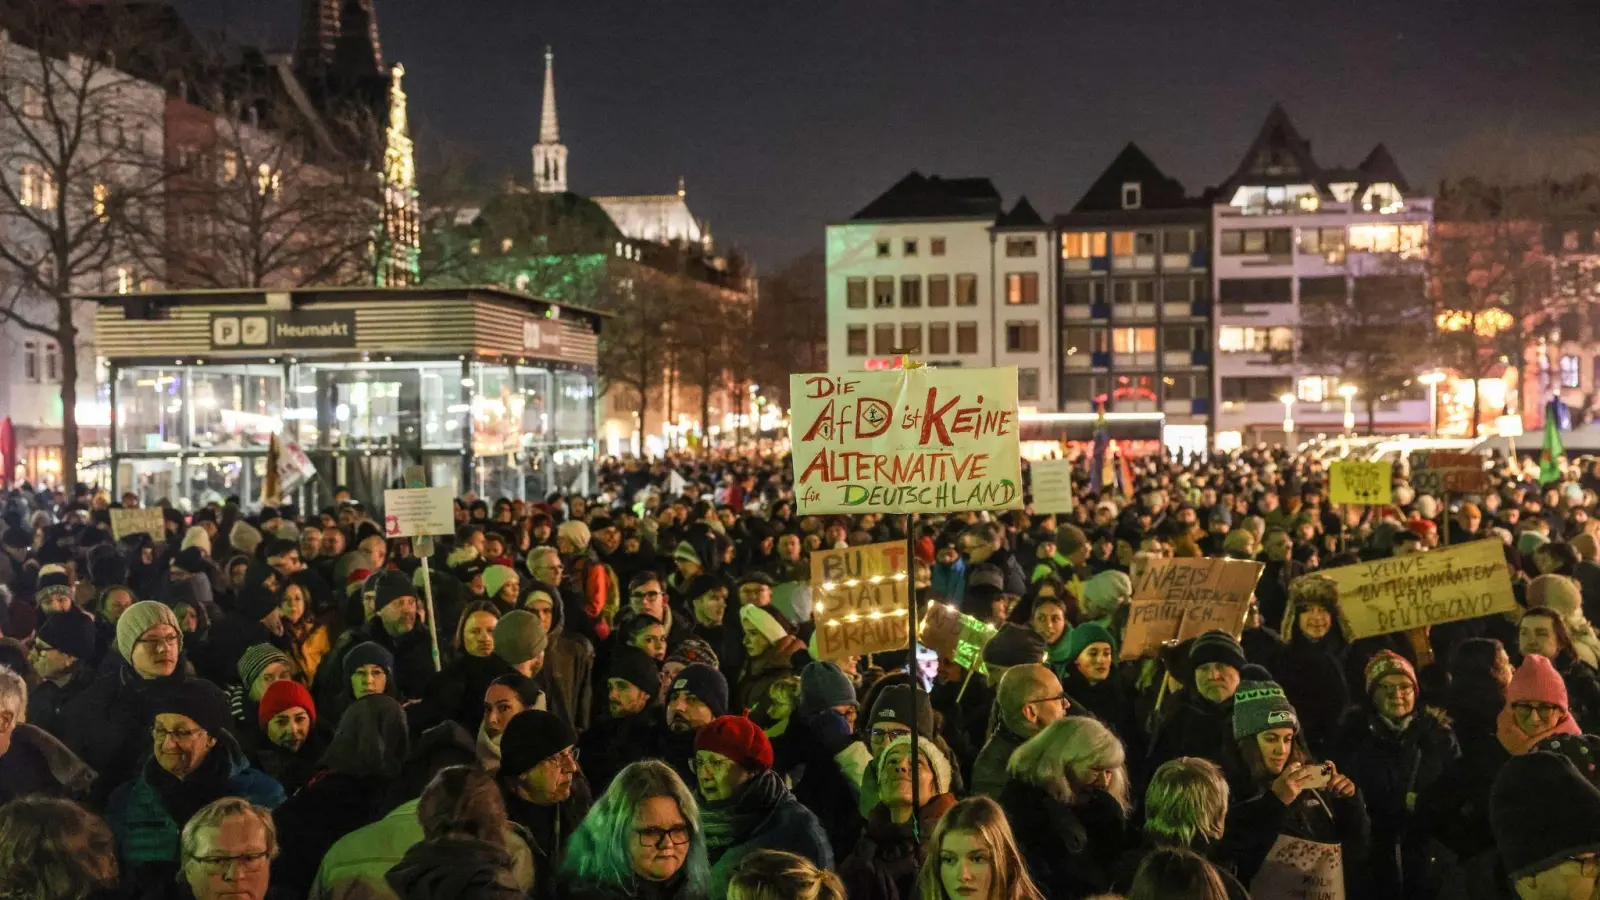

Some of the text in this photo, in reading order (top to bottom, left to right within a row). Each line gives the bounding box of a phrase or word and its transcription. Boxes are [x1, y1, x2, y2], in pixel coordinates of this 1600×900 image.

[277, 321, 348, 337] Heumarkt
[802, 398, 893, 444] AfD
[901, 405, 924, 429] ist
[836, 479, 1015, 508] DEUTSCHLAND
[822, 548, 905, 580] BUNT
[825, 580, 899, 611] STATT
[1378, 592, 1494, 631] DEUTSCHLAND
[823, 617, 908, 654] BRAUN
